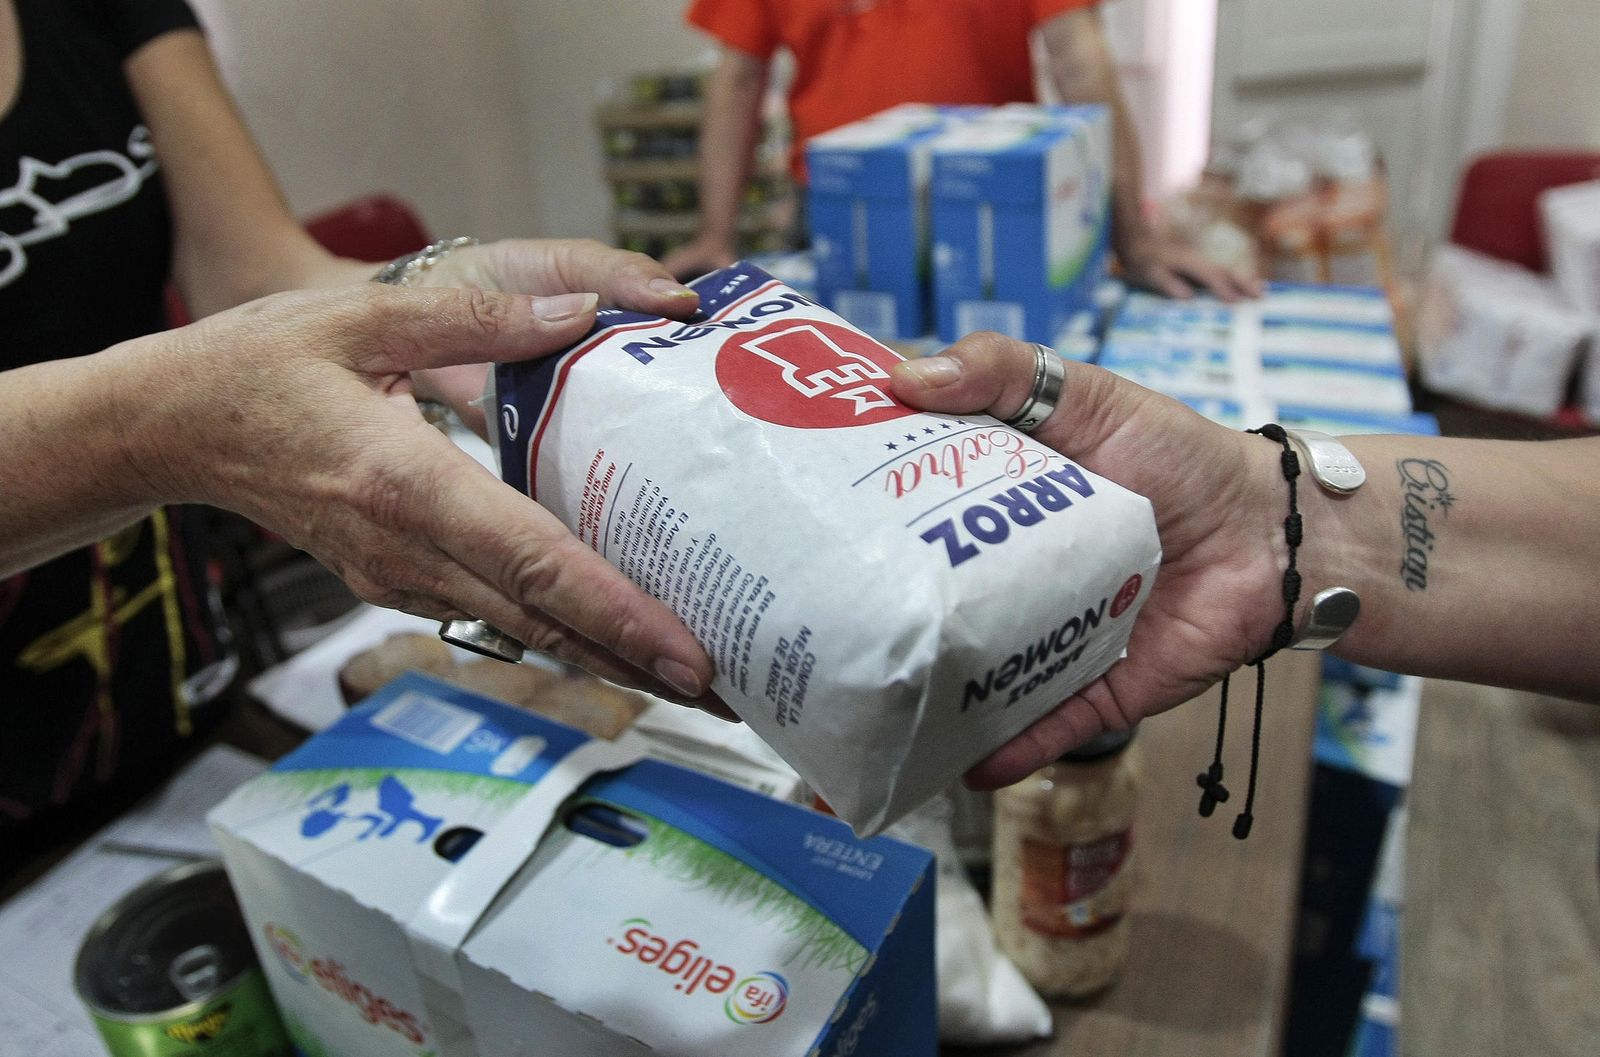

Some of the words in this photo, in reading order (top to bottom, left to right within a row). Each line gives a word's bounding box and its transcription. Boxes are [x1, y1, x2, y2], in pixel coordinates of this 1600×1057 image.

[584, 448, 605, 484] SEGURO
[599, 462, 617, 493] ARROZ
[885, 430, 1049, 499] Extra
[582, 485, 590, 499] EN
[592, 478, 602, 491] SU
[651, 485, 660, 496] el
[585, 493, 596, 529] TRIUNFO
[593, 493, 605, 521] EXTRA
[618, 510, 627, 523] de
[628, 484, 648, 519] absorba
[637, 495, 655, 525] mismo
[645, 495, 668, 536] variedad
[664, 507, 676, 519] es
[920, 464, 1095, 568] ARROZ
[677, 511, 689, 523] El
[1398, 458, 1450, 592] Cristian
[629, 526, 643, 556] tiempo
[640, 534, 649, 556] para
[648, 519, 668, 556] siempre
[662, 523, 680, 550] Arroz
[692, 532, 717, 571] deshace
[656, 551, 669, 576] Extra
[671, 549, 680, 562] en
[678, 545, 694, 575] queda
[682, 571, 697, 607] durante
[721, 564, 742, 598] mucho
[727, 572, 755, 615] Contiene
[757, 590, 776, 613] Este
[773, 636, 790, 658] DE
[784, 625, 813, 675] MEJOR
[763, 657, 784, 702] ARROZ
[790, 651, 817, 708] COMPRE
[788, 708, 801, 725] LA
[615, 925, 736, 996] eliges
[745, 985, 776, 1010] ifa
